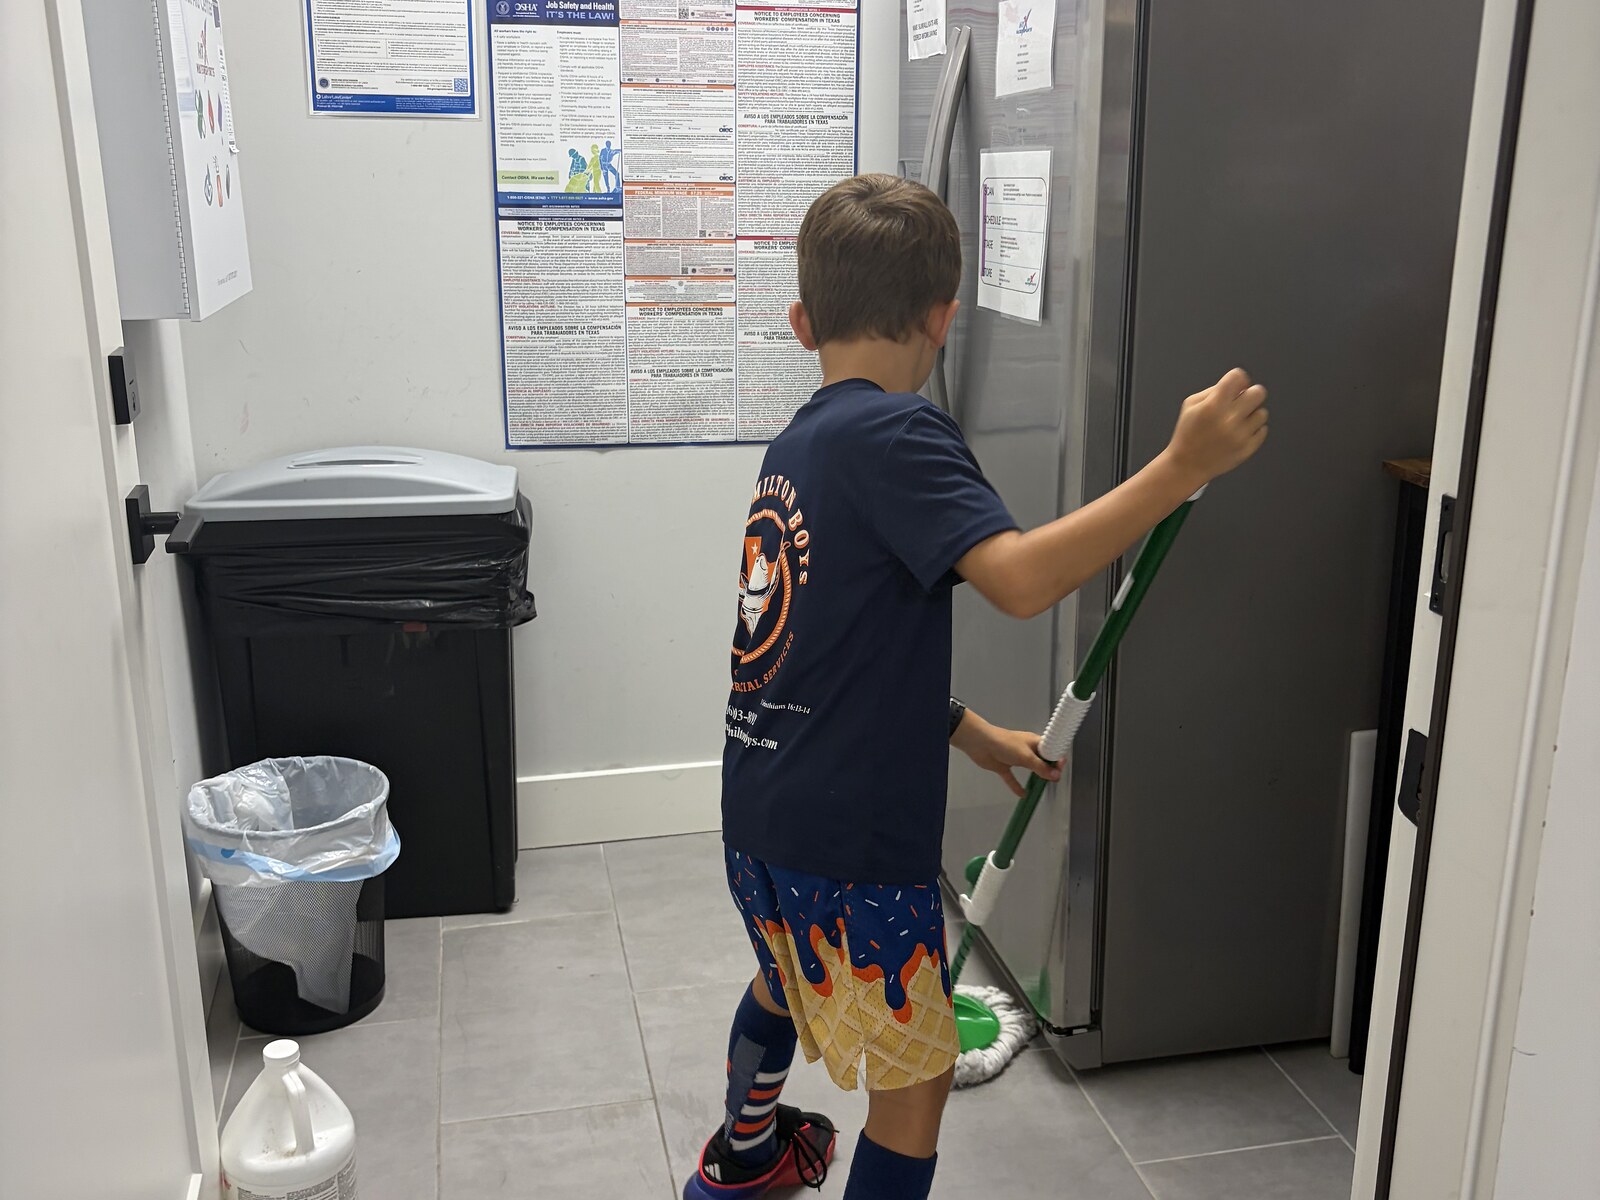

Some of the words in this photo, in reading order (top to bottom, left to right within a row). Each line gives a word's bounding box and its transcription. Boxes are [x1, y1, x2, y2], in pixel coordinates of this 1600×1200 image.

[546, 1, 558, 10] Job
[559, 1, 579, 11] Safety
[593, 3, 614, 11] Health
[589, 12, 614, 20] LAW!
[788, 508, 810, 585] BOYS
[763, 631, 794, 684] SERVICES
[788, 703, 811, 714] 16:13-14
